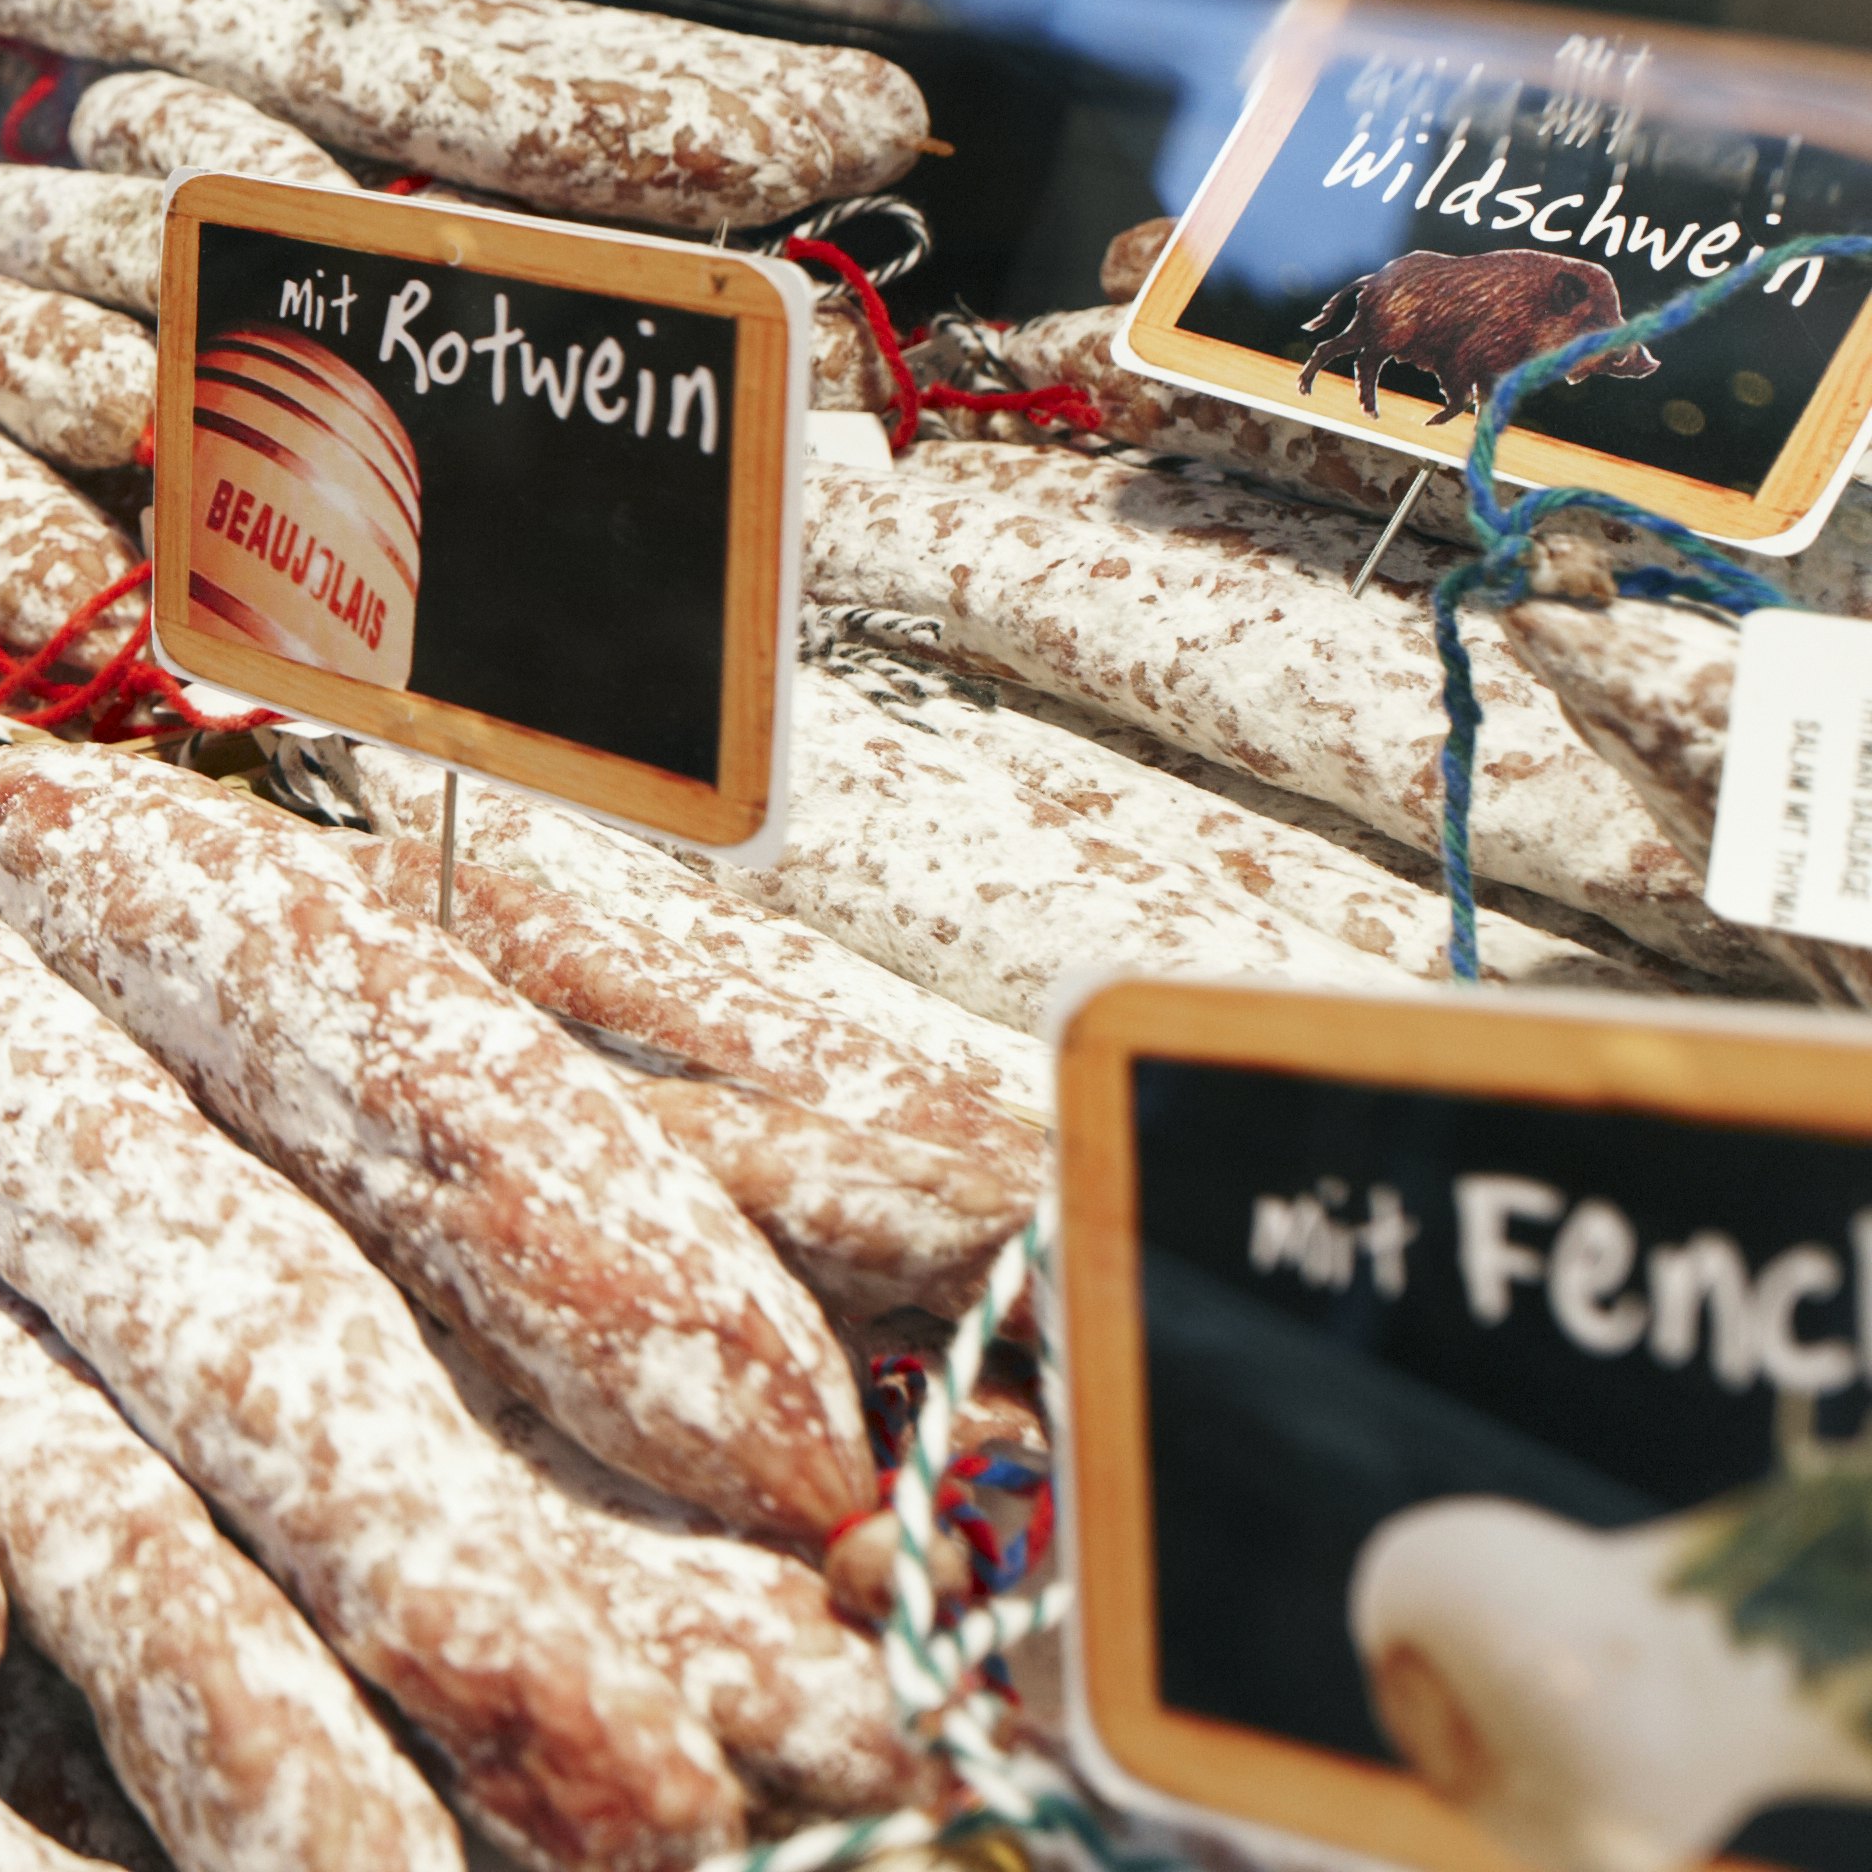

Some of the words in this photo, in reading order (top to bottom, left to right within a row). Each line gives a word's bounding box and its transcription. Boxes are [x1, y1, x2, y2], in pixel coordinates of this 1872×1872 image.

[277, 268, 360, 340] mit
[378, 278, 723, 457] Rotwein
[205, 476, 390, 654] BEAUJOLAIS
[1249, 1174, 1422, 1301] mit
[1454, 1171, 1872, 1396] Fenc
